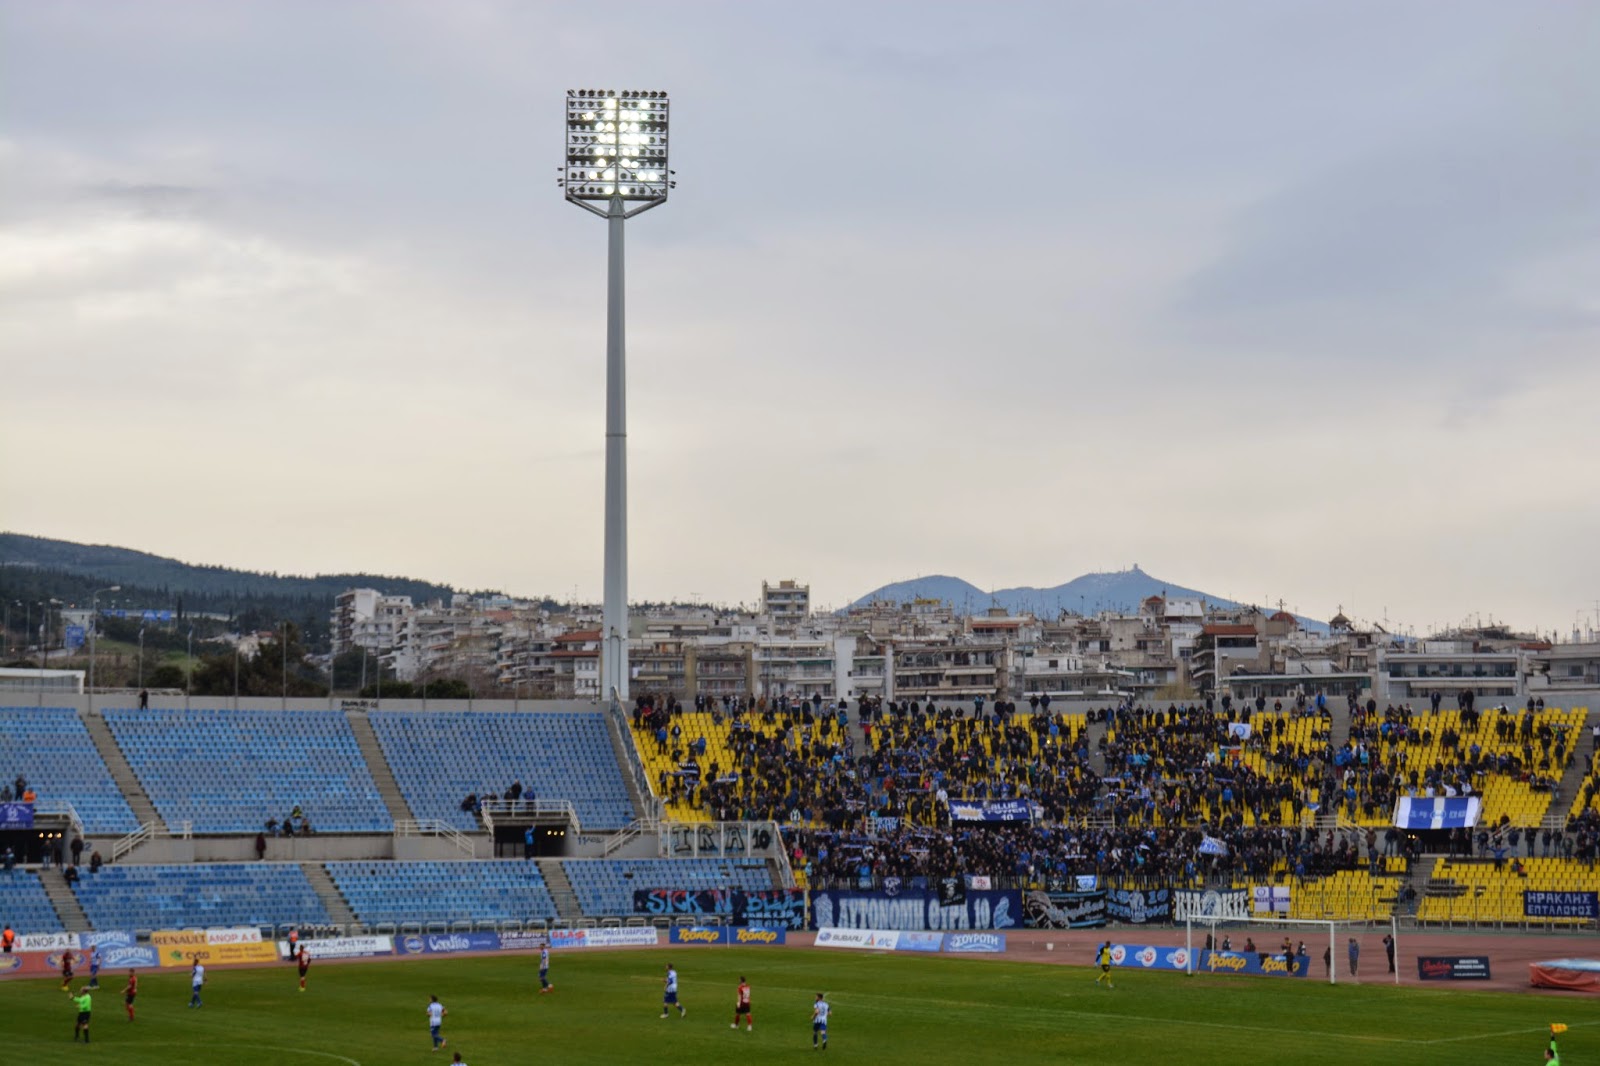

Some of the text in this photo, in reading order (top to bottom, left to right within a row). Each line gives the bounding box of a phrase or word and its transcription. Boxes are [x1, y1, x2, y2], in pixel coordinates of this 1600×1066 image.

[752, 829, 771, 849] 10
[645, 889, 703, 914] SICK
[1527, 892, 1591, 904] ΗΡΑΚΛΗΣ
[838, 898, 925, 930] ΑΥΤΟΝΟΜΗ
[974, 898, 991, 929] 10
[1527, 905, 1592, 915] ΕΠΤΑΛΟΦΟΣ
[154, 933, 206, 945] RENAULT
[832, 934, 863, 943] SUBARU
